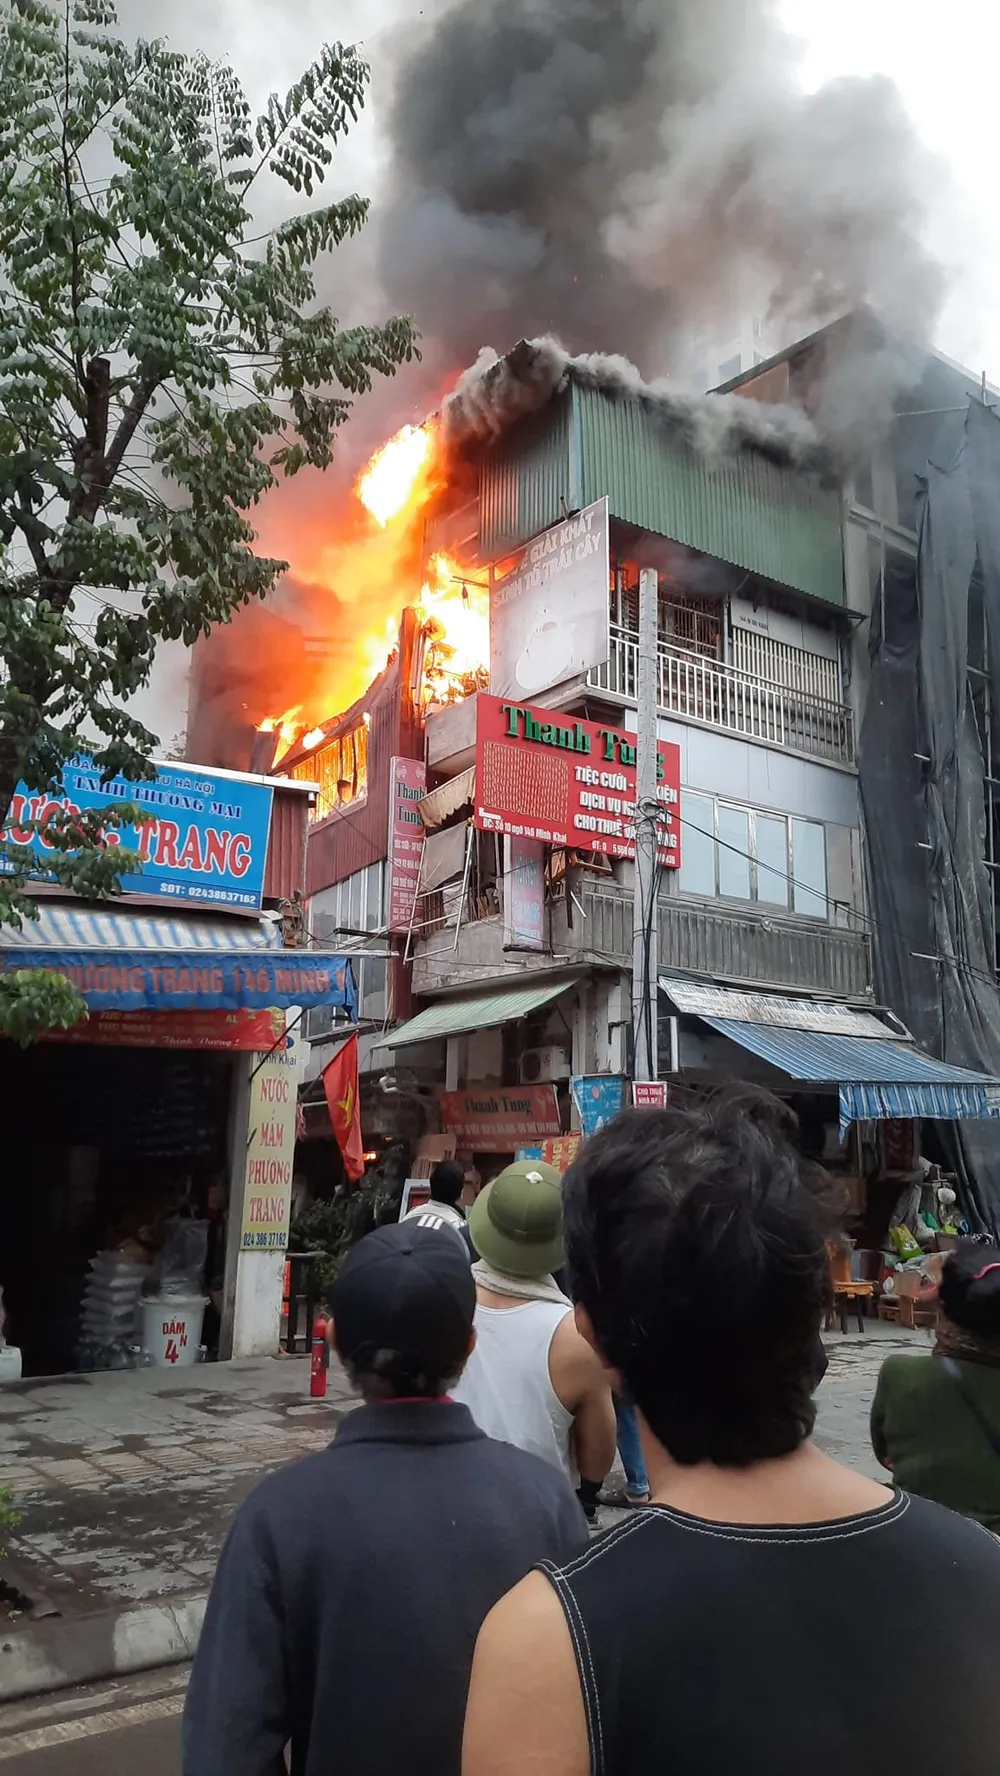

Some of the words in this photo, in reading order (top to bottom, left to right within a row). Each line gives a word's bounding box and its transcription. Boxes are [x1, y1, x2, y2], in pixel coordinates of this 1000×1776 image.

[575, 532, 601, 561] CÂY
[500, 704, 592, 754] Thanh
[175, 776, 191, 789] HÀ
[195, 782, 215, 796] NỘI
[396, 781, 425, 801] Thanh
[575, 766, 599, 785] TIỆC
[600, 772, 627, 792] CƯỚI
[132, 786, 205, 811] THƯƠNG
[210, 801, 243, 819] MẠI
[580, 791, 605, 810] DỊCH
[606, 797, 621, 816] VỤ
[504, 822, 511, 832] 10
[536, 828, 551, 840] Minh
[552, 831, 567, 843] Khai
[574, 814, 596, 832] CHO
[596, 817, 622, 836] THUÊ
[135, 819, 252, 878] TRANG
[188, 887, 257, 904] 02438637162
[151, 966, 224, 993] TRANG
[232, 967, 270, 993] 146
[275, 967, 330, 993] MINH
[260, 1072, 289, 1103] NƯỚC
[248, 1158, 290, 1185] PHƯƠNG
[250, 1197, 284, 1222] TRANG
